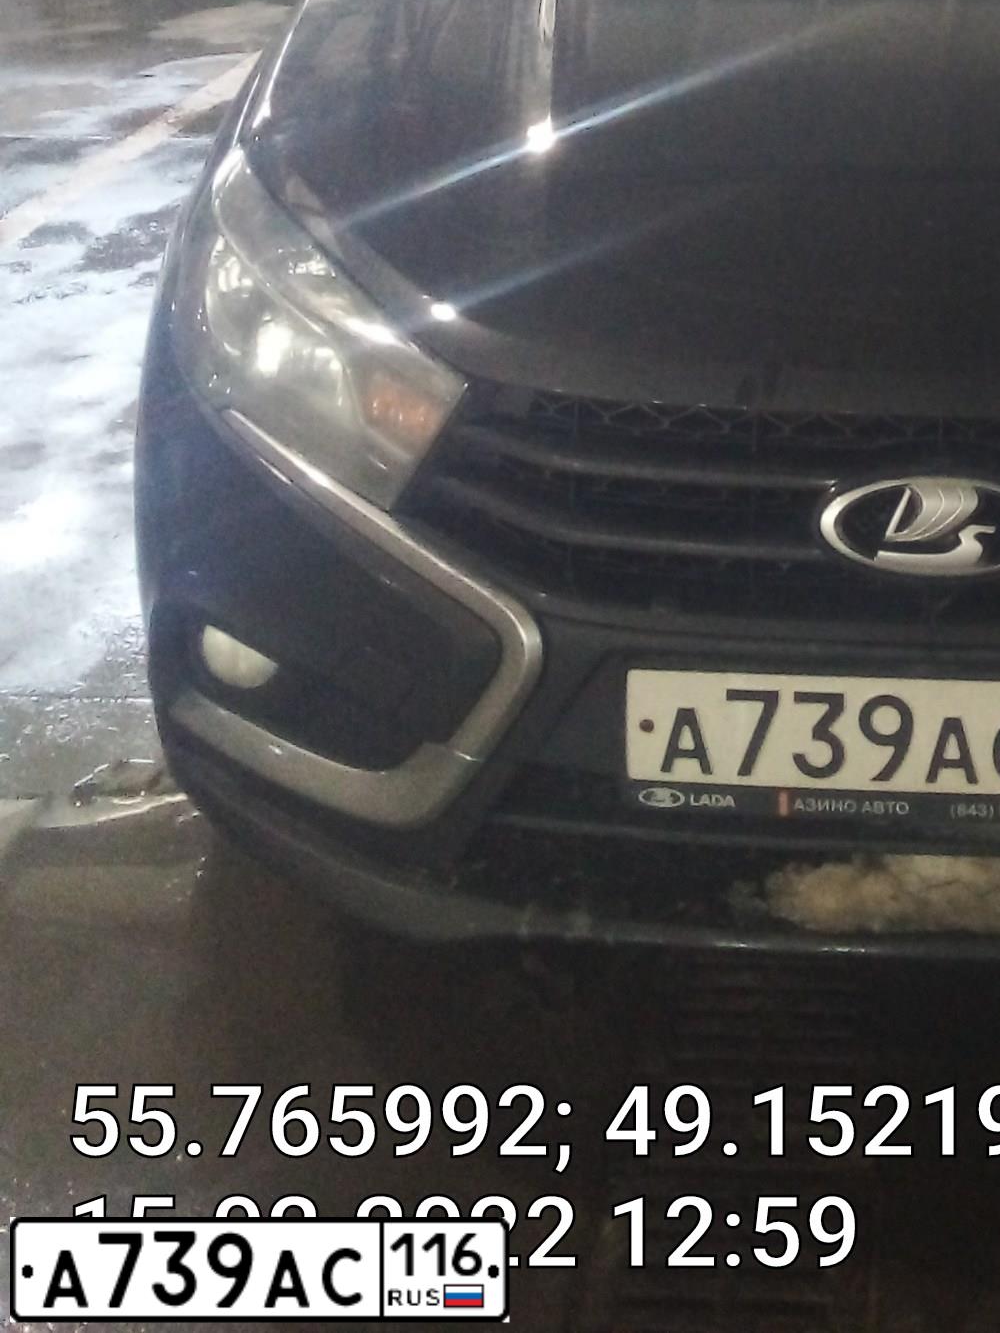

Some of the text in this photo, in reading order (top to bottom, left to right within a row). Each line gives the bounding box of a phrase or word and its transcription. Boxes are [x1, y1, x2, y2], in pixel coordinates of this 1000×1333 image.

[689, 792, 737, 809] LADA
[793, 796, 911, 816] АЗИНО АВТО
